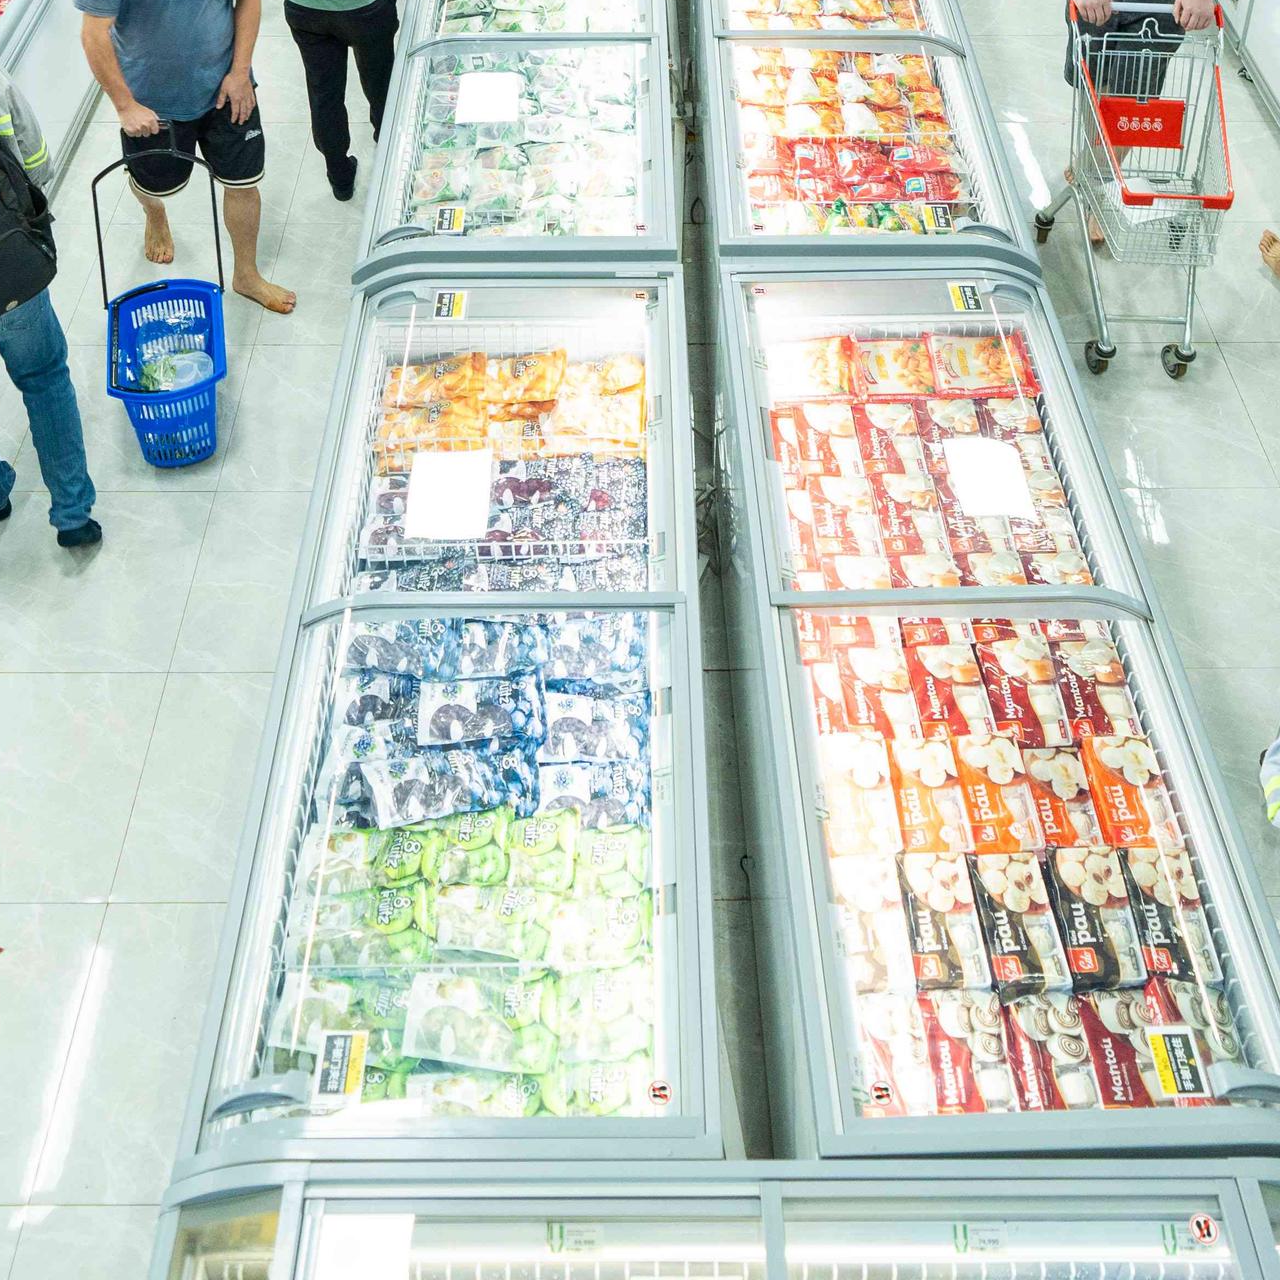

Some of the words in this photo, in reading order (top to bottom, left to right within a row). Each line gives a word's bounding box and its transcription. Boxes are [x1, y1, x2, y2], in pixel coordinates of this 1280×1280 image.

[930, 676, 942, 720] Mantou
[1004, 675, 1015, 720] Mantou
[1072, 674, 1086, 719] Mantou
[981, 784, 999, 821] pau
[1045, 798, 1063, 839] pau
[1116, 784, 1135, 821] pau
[386, 831, 411, 868] Fruitz
[377, 888, 397, 926] Fruitz
[396, 896, 412, 910] 8
[1071, 902, 1097, 944] pau
[1150, 903, 1172, 945] pau
[921, 909, 940, 953] pau
[995, 909, 1021, 953] pau
[938, 1041, 959, 1106] Mantou
[1024, 1036, 1042, 1107] Mantou
[1105, 1036, 1126, 1102] Mantou
